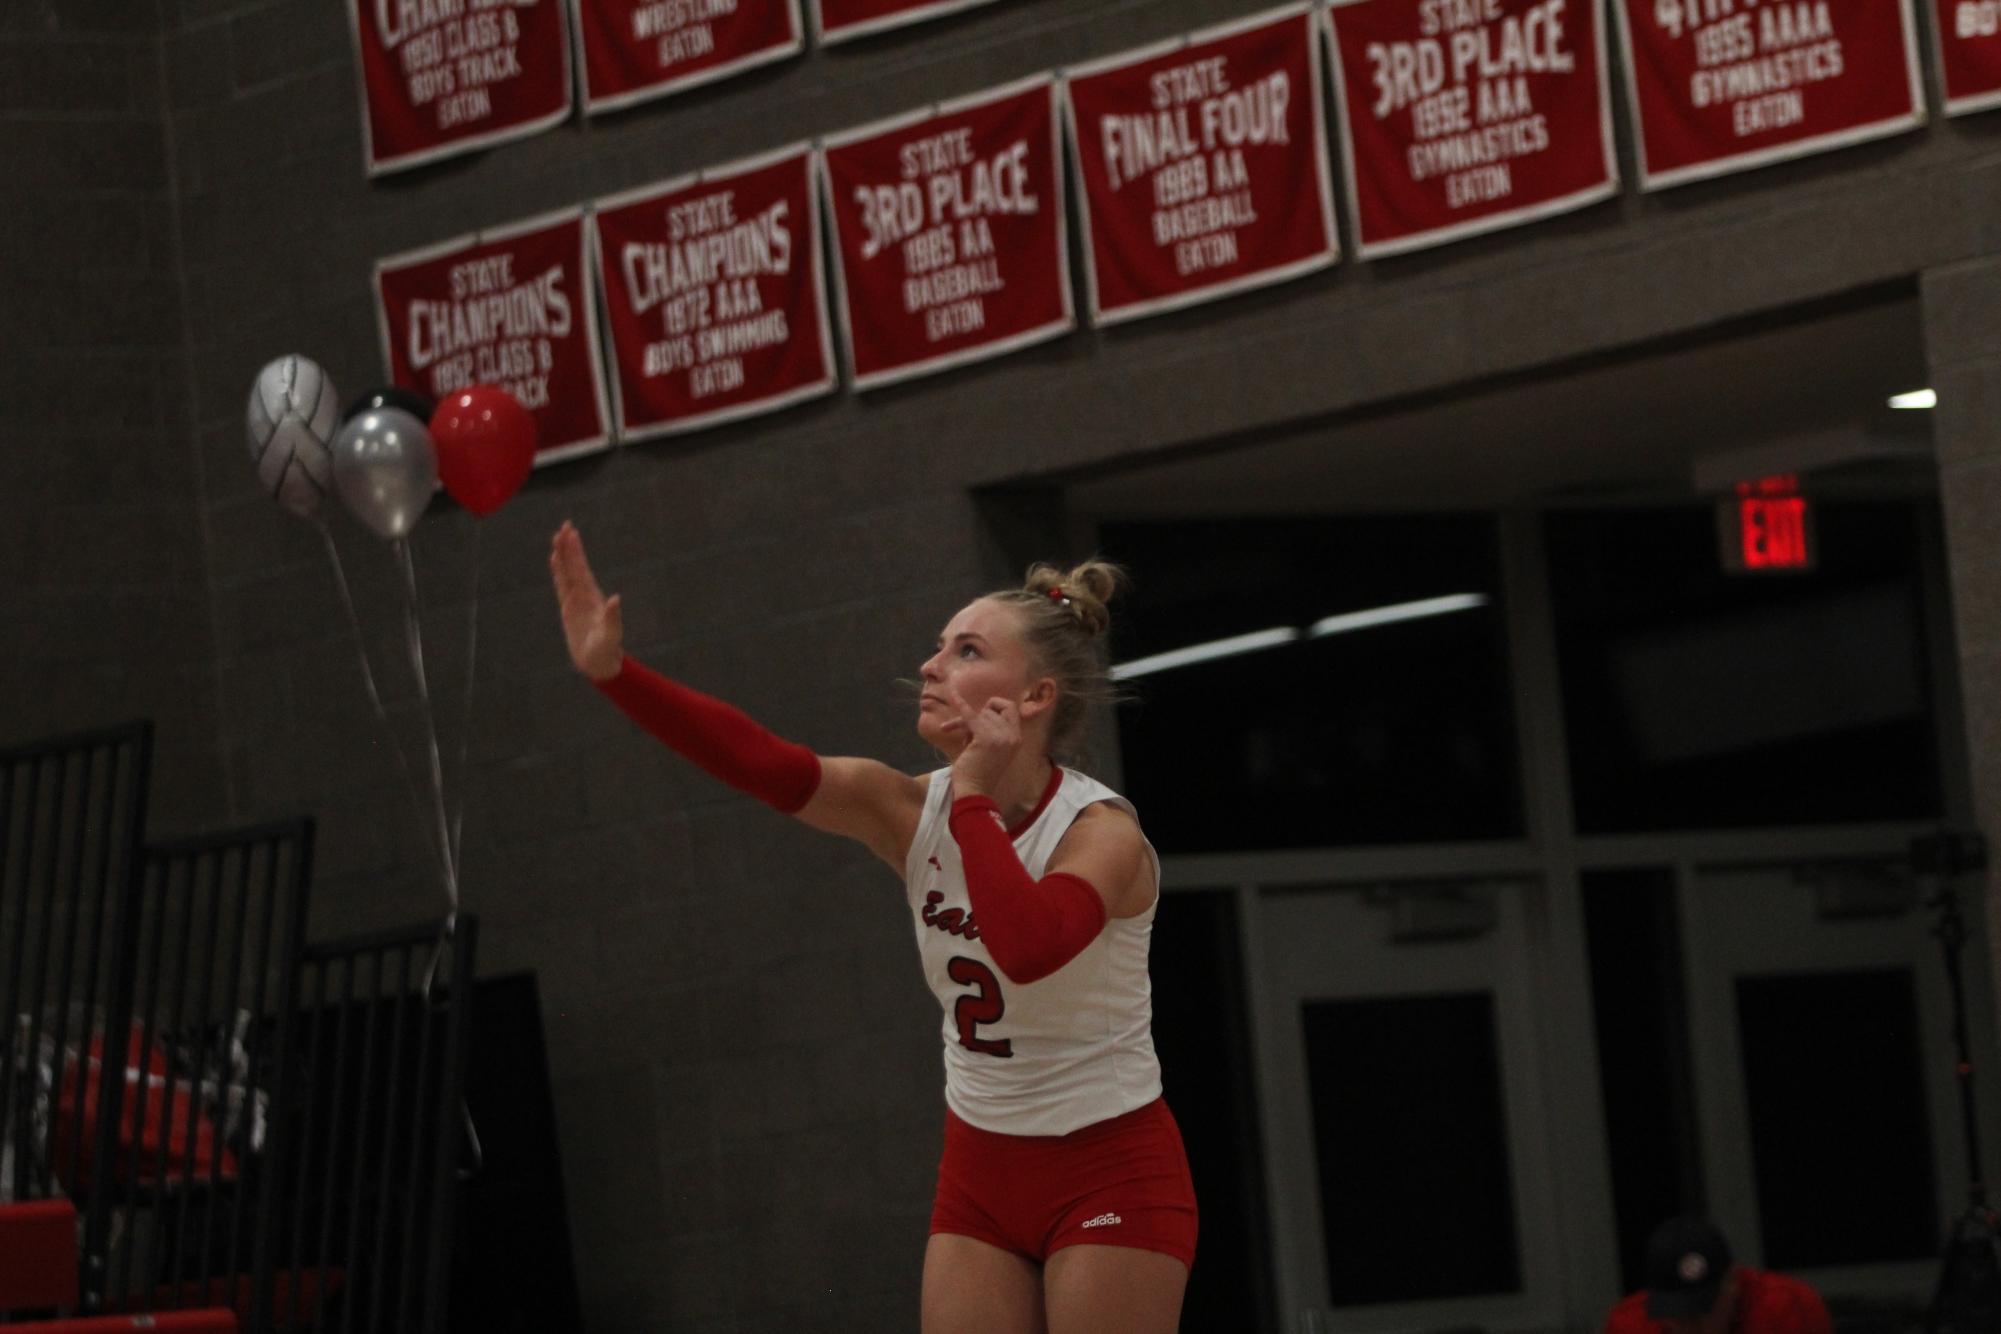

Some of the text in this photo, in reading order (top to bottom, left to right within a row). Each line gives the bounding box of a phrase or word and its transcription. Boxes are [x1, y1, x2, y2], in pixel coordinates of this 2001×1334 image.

[445, 11, 501, 60] CLASS
[658, 22, 714, 68] EATON
[1758, 1, 1833, 51] AAAA
[409, 45, 522, 106] BOYS TRACK
[1150, 54, 1230, 110] STATE
[1366, 37, 1444, 121] 3RD
[1451, 0, 1576, 82] PLACE
[1690, 38, 1844, 109] GYMNASTICS
[437, 87, 492, 130] EATON
[1476, 76, 1532, 125] AAA
[1733, 88, 1803, 138] EATON
[900, 126, 974, 178] STATE
[1101, 68, 1290, 192] FINAL FOUR
[1407, 111, 1549, 182] GYMNASTICS
[1213, 148, 1249, 191] AA
[1445, 161, 1512, 209] EATON
[666, 190, 737, 241] STATE
[854, 138, 1039, 261] 3RD PLACE
[1152, 190, 1257, 248] BASEBALL
[622, 198, 791, 315] CHAMPIONS
[959, 216, 996, 258] AA
[1175, 230, 1238, 277] EATON
[451, 252, 515, 299] STATE
[714, 276, 763, 320] AAA
[903, 255, 1005, 314] BASEBALL
[409, 263, 572, 369] CHAMPIONS
[926, 296, 986, 343] EATON
[477, 339, 535, 382] CLASS
[643, 307, 789, 378] BOYS SWIMMING
[690, 356, 745, 399] EATON
[947, 956, 1014, 1058] 2
[1082, 1213, 1122, 1229] adidas
